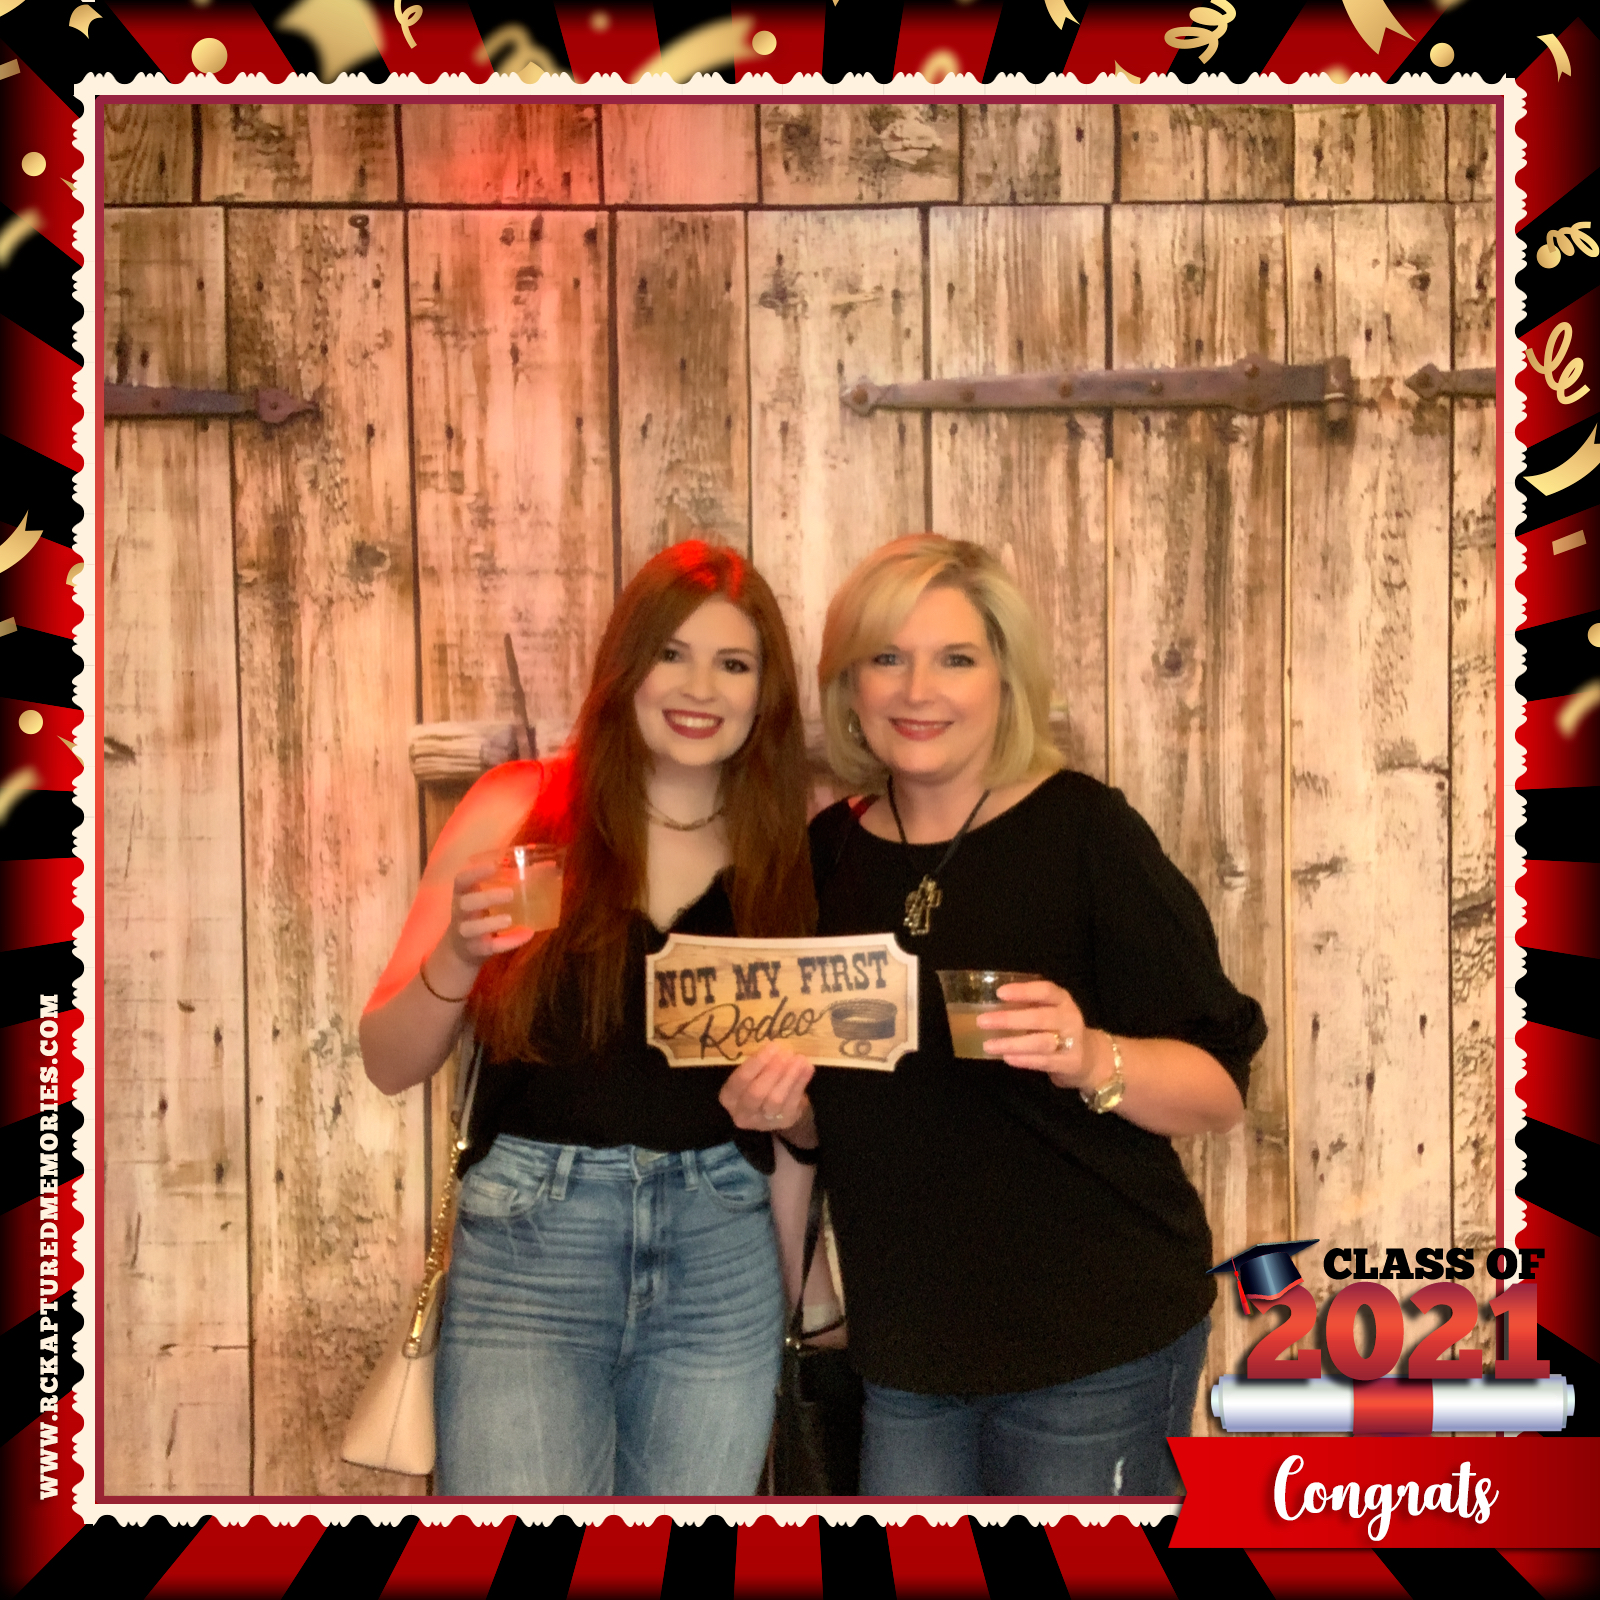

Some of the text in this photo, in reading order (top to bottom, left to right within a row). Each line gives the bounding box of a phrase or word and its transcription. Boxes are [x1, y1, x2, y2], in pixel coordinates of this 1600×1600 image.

[655, 950, 889, 1009] NOT MY FIRST
[696, 996, 819, 1060] Rodeo
